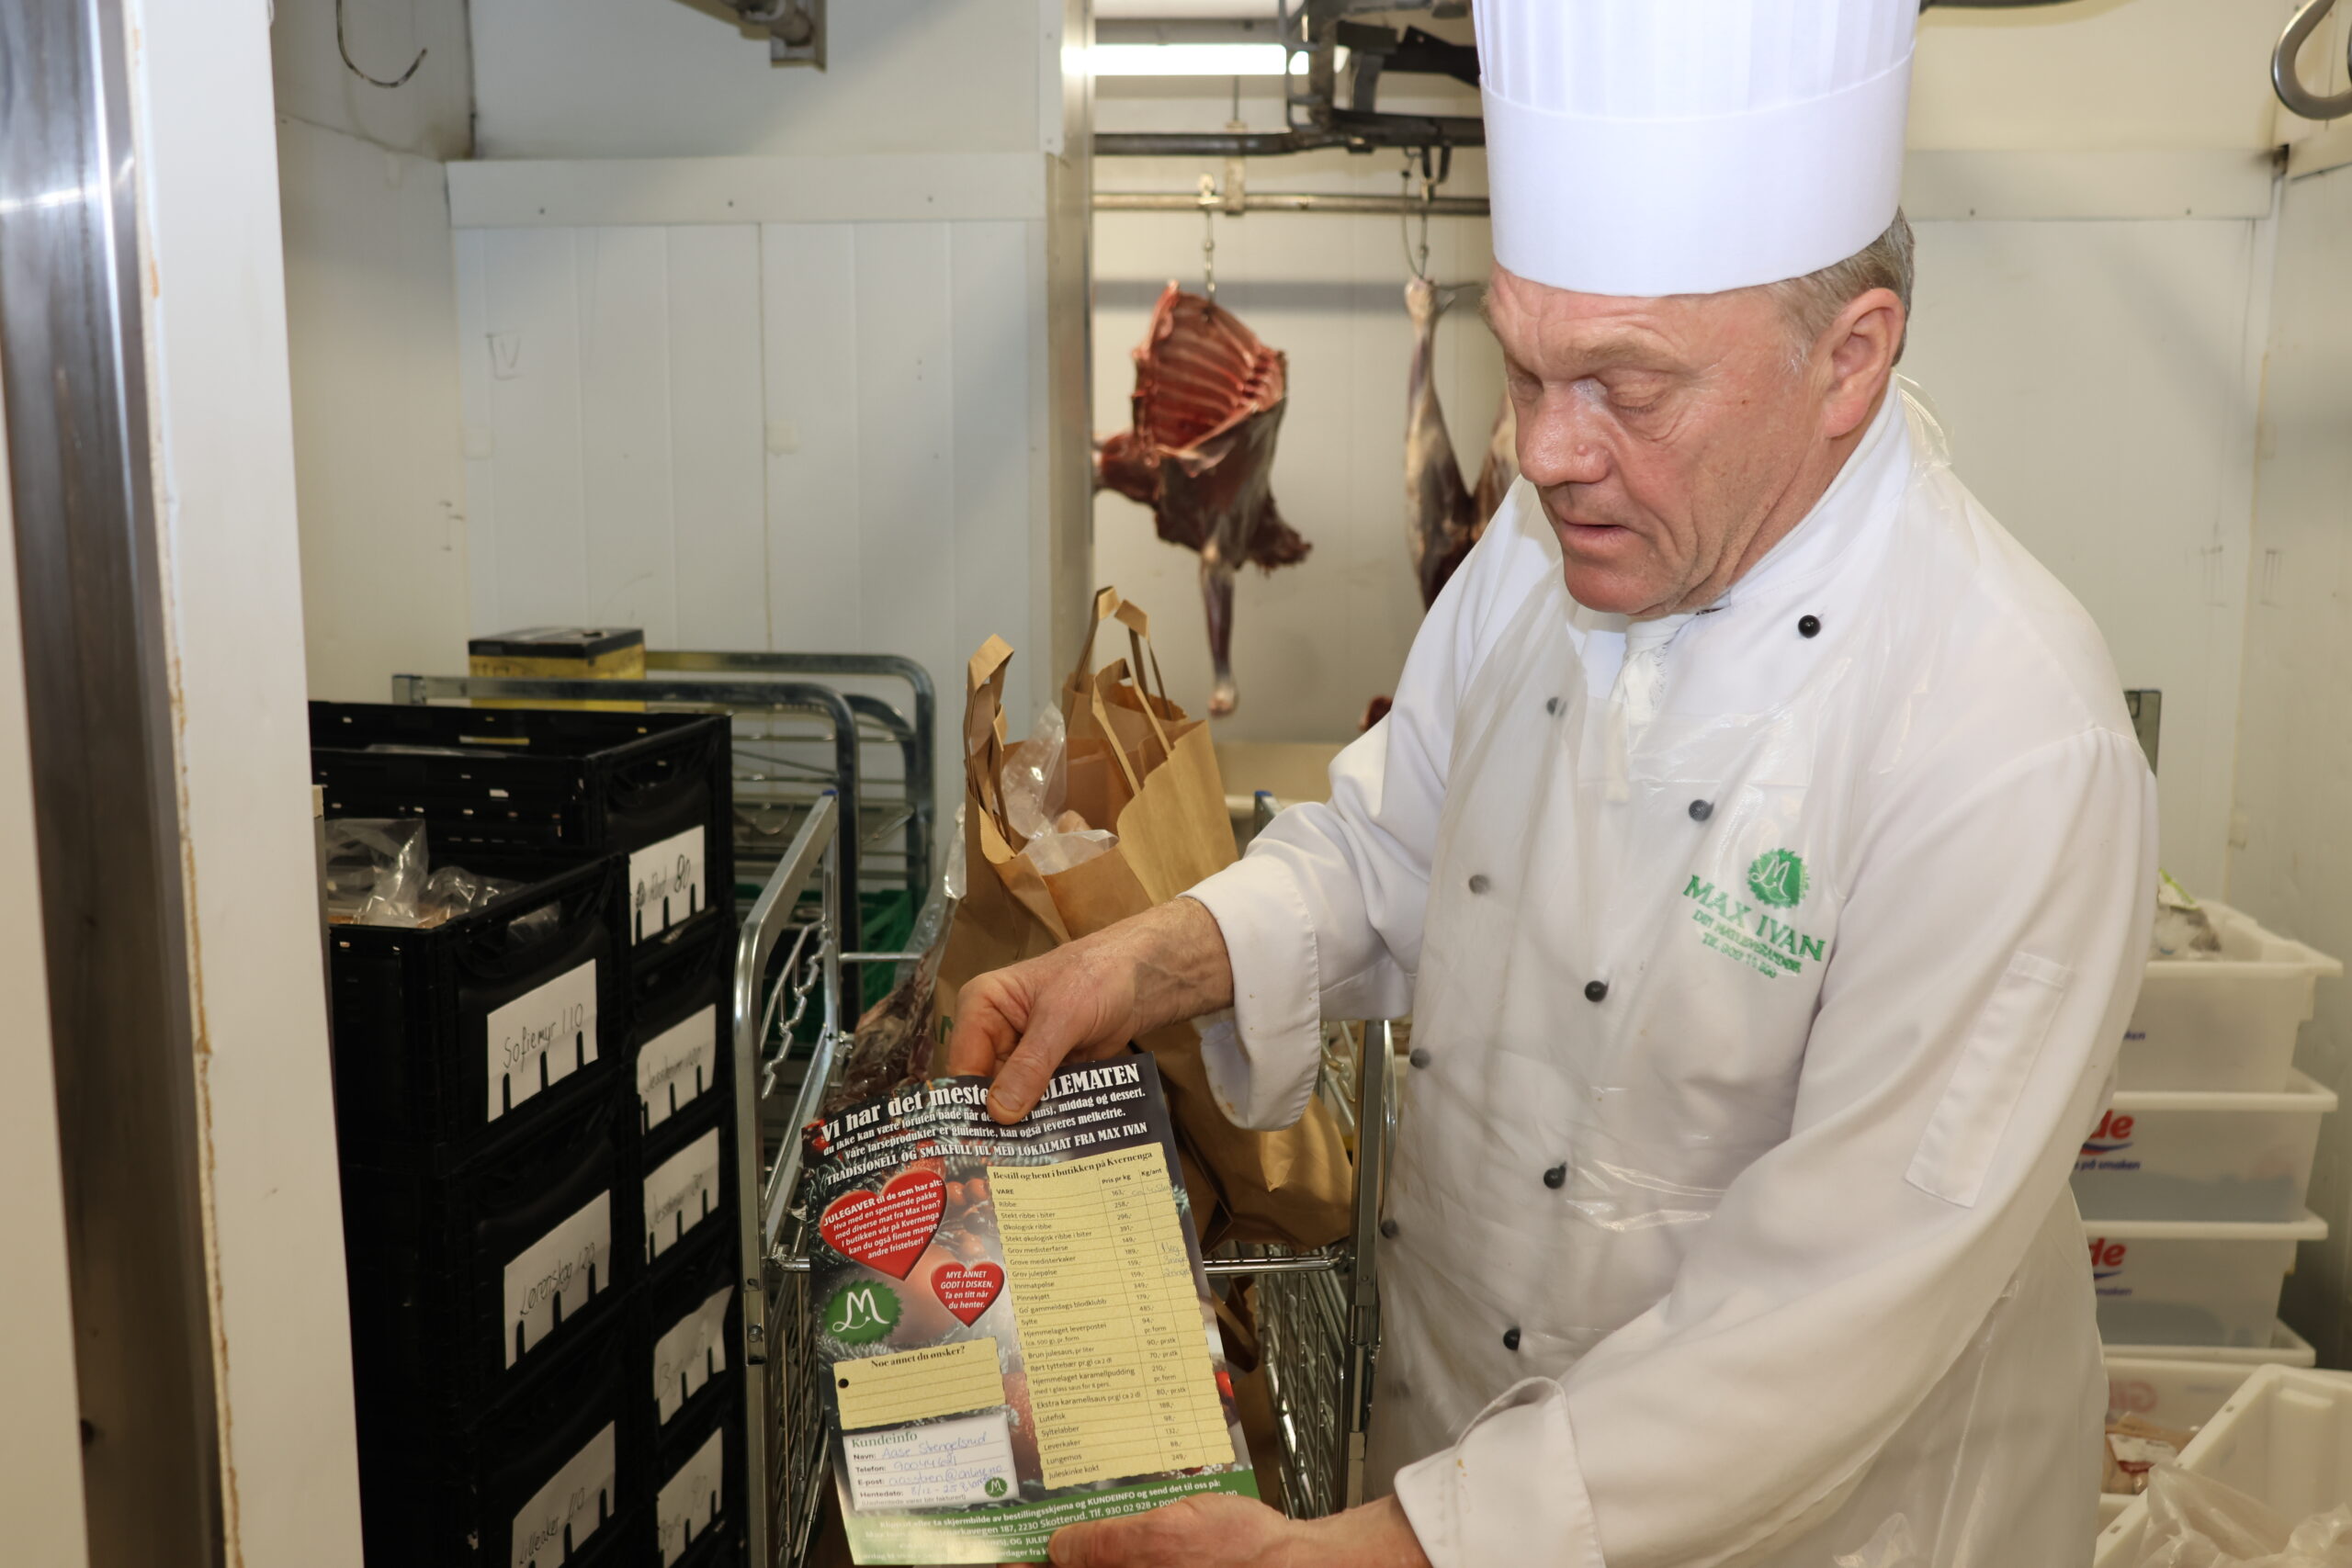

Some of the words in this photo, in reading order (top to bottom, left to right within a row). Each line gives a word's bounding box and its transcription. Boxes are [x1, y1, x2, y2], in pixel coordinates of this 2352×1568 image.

[673, 852, 691, 894] 80
[1683, 874, 1752, 929] MAX
[1756, 914, 1826, 961] IVAN
[503, 1021, 557, 1073] Sofiemyr
[561, 1002, 584, 1034] 110
[820, 1121, 841, 1142] Vi
[845, 1104, 881, 1133] har
[888, 1092, 922, 1117] det
[929, 1085, 989, 1106] meste
[1040, 1063, 1140, 1101] ULEMATEN
[823, 1145, 834, 1156] du
[836, 1135, 855, 1151] ikke
[857, 1130, 875, 1141] kan
[876, 1122, 899, 1135] være
[902, 1113, 935, 1128] foruten
[938, 1110, 961, 1121] både
[964, 1111, 978, 1122] når
[1032, 1106, 1057, 1120] lunsj,
[1058, 1097, 1094, 1112] middag
[1097, 1094, 1108, 1105] og
[1110, 1088, 1146, 1102] dessert.
[845, 1146, 865, 1159] Våre
[868, 1128, 936, 1153] farseprodukter
[939, 1126, 948, 1135] er
[951, 1125, 999, 1139] glutenfrie,
[1000, 1126, 1018, 1138] kan
[1020, 1122, 1042, 1138] også
[1044, 1117, 1076, 1133] leveres
[1078, 1108, 1125, 1124] melkefrie.
[826, 1156, 899, 1186] TRADISJONELL
[900, 1151, 917, 1163] OG
[920, 1145, 972, 1158] SMAKFULL
[974, 1145, 990, 1156] JUL
[993, 1146, 1015, 1156] MED
[1018, 1137, 1071, 1156] LOKALMAT
[1075, 1134, 1095, 1147] FRA
[1097, 1129, 1121, 1141] MAX
[1123, 1122, 1148, 1136] IVAN
[993, 1171, 1020, 1179] Bestill
[1020, 1172, 1031, 1181] og
[1032, 1170, 1050, 1179] hent
[1052, 1169, 1056, 1178] i
[1056, 1163, 1095, 1178] butikken
[1096, 1160, 1106, 1171] på
[1107, 1152, 1153, 1167] Kvernenga
[2098, 1159, 2140, 1170] smaken
[1123, 1174, 1132, 1182] kg
[1141, 1168, 1162, 1178] Kg/ant
[823, 1198, 876, 1226] JULEGAVER
[876, 1196, 885, 1204] til
[887, 1192, 897, 1201] de
[898, 1188, 914, 1197] som
[914, 1183, 928, 1192] har
[929, 1179, 943, 1188] alt:
[833, 1222, 847, 1231] Hva
[848, 1214, 864, 1225] med
[865, 1211, 874, 1219] en
[876, 1198, 914, 1215] spennende
[916, 1192, 937, 1203] pakke
[835, 1230, 851, 1240] med
[852, 1221, 877, 1233] diverse
[878, 1214, 893, 1224] mat
[894, 1211, 903, 1220] fra
[905, 1208, 921, 1216] Max
[922, 1200, 941, 1212] Ivan?
[845, 1230, 877, 1246] butikken
[877, 1225, 890, 1235] vår
[891, 1224, 900, 1233] på
[901, 1213, 940, 1227] Kvernenga
[1023, 1235, 1053, 1243] økologisk
[1055, 1232, 1071, 1240] ribbe
[849, 1247, 862, 1255] kan
[864, 1240, 873, 1249] du
[874, 1234, 891, 1247] også
[892, 1231, 911, 1241] finne
[912, 1224, 937, 1235] mange
[867, 1247, 888, 1259] andre
[889, 1236, 924, 1251] fristelser!
[1025, 1245, 1069, 1253] medisterfarse
[1030, 1255, 1076, 1265] medisterkaker
[945, 1270, 962, 1279] MYE
[963, 1270, 987, 1279] ANNET
[1028, 1269, 1057, 1279] julepølse
[940, 1281, 960, 1290] GODT
[948, 1301, 958, 1309] du
[1031, 1303, 1073, 1314] gammeldags
[1073, 1298, 1106, 1308] blodklubb
[1021, 1318, 1038, 1326] Sylte
[1023, 1327, 1069, 1337] Hjemmelaget
[1069, 1322, 1106, 1334] leverpostei
[871, 1359, 888, 1368] Noe
[890, 1355, 915, 1365] annet
[917, 1350, 929, 1360] du
[1046, 1360, 1077, 1371] tyttebær
[1032, 1374, 1079, 1386] Hjemmelaget
[1079, 1368, 1136, 1381] karamellpudding
[1036, 1401, 1059, 1409] Ekstra
[1060, 1395, 1107, 1405] karamellsaus
[1039, 1413, 1066, 1423] Lutefisk
[1041, 1425, 1080, 1437] Syltelabber
[852, 1432, 918, 1448] Kundeinfo
[1044, 1439, 1081, 1451] Leverkaker
[1048, 1467, 1083, 1480] Juleskinke
[1084, 1464, 1100, 1472] kokt
[944, 1517, 991, 1527] skjermbilde
[1003, 1503, 1073, 1521] bestillingsskjema
[1088, 1492, 1135, 1506] KUNDEINFO
[1137, 1491, 1148, 1500] og
[1148, 1487, 1169, 1495] send
[1170, 1485, 1183, 1494] det
[1184, 1483, 1193, 1491] til
[1194, 1482, 1207, 1490] oss
[1209, 1480, 1221, 1490] på:
[1001, 1526, 1016, 1534] 187,
[1018, 1523, 1039, 1531] 2230
[1040, 1513, 1088, 1528] Skotterud.
[1105, 1506, 1122, 1517] 930
[1136, 1502, 1151, 1511] 928
